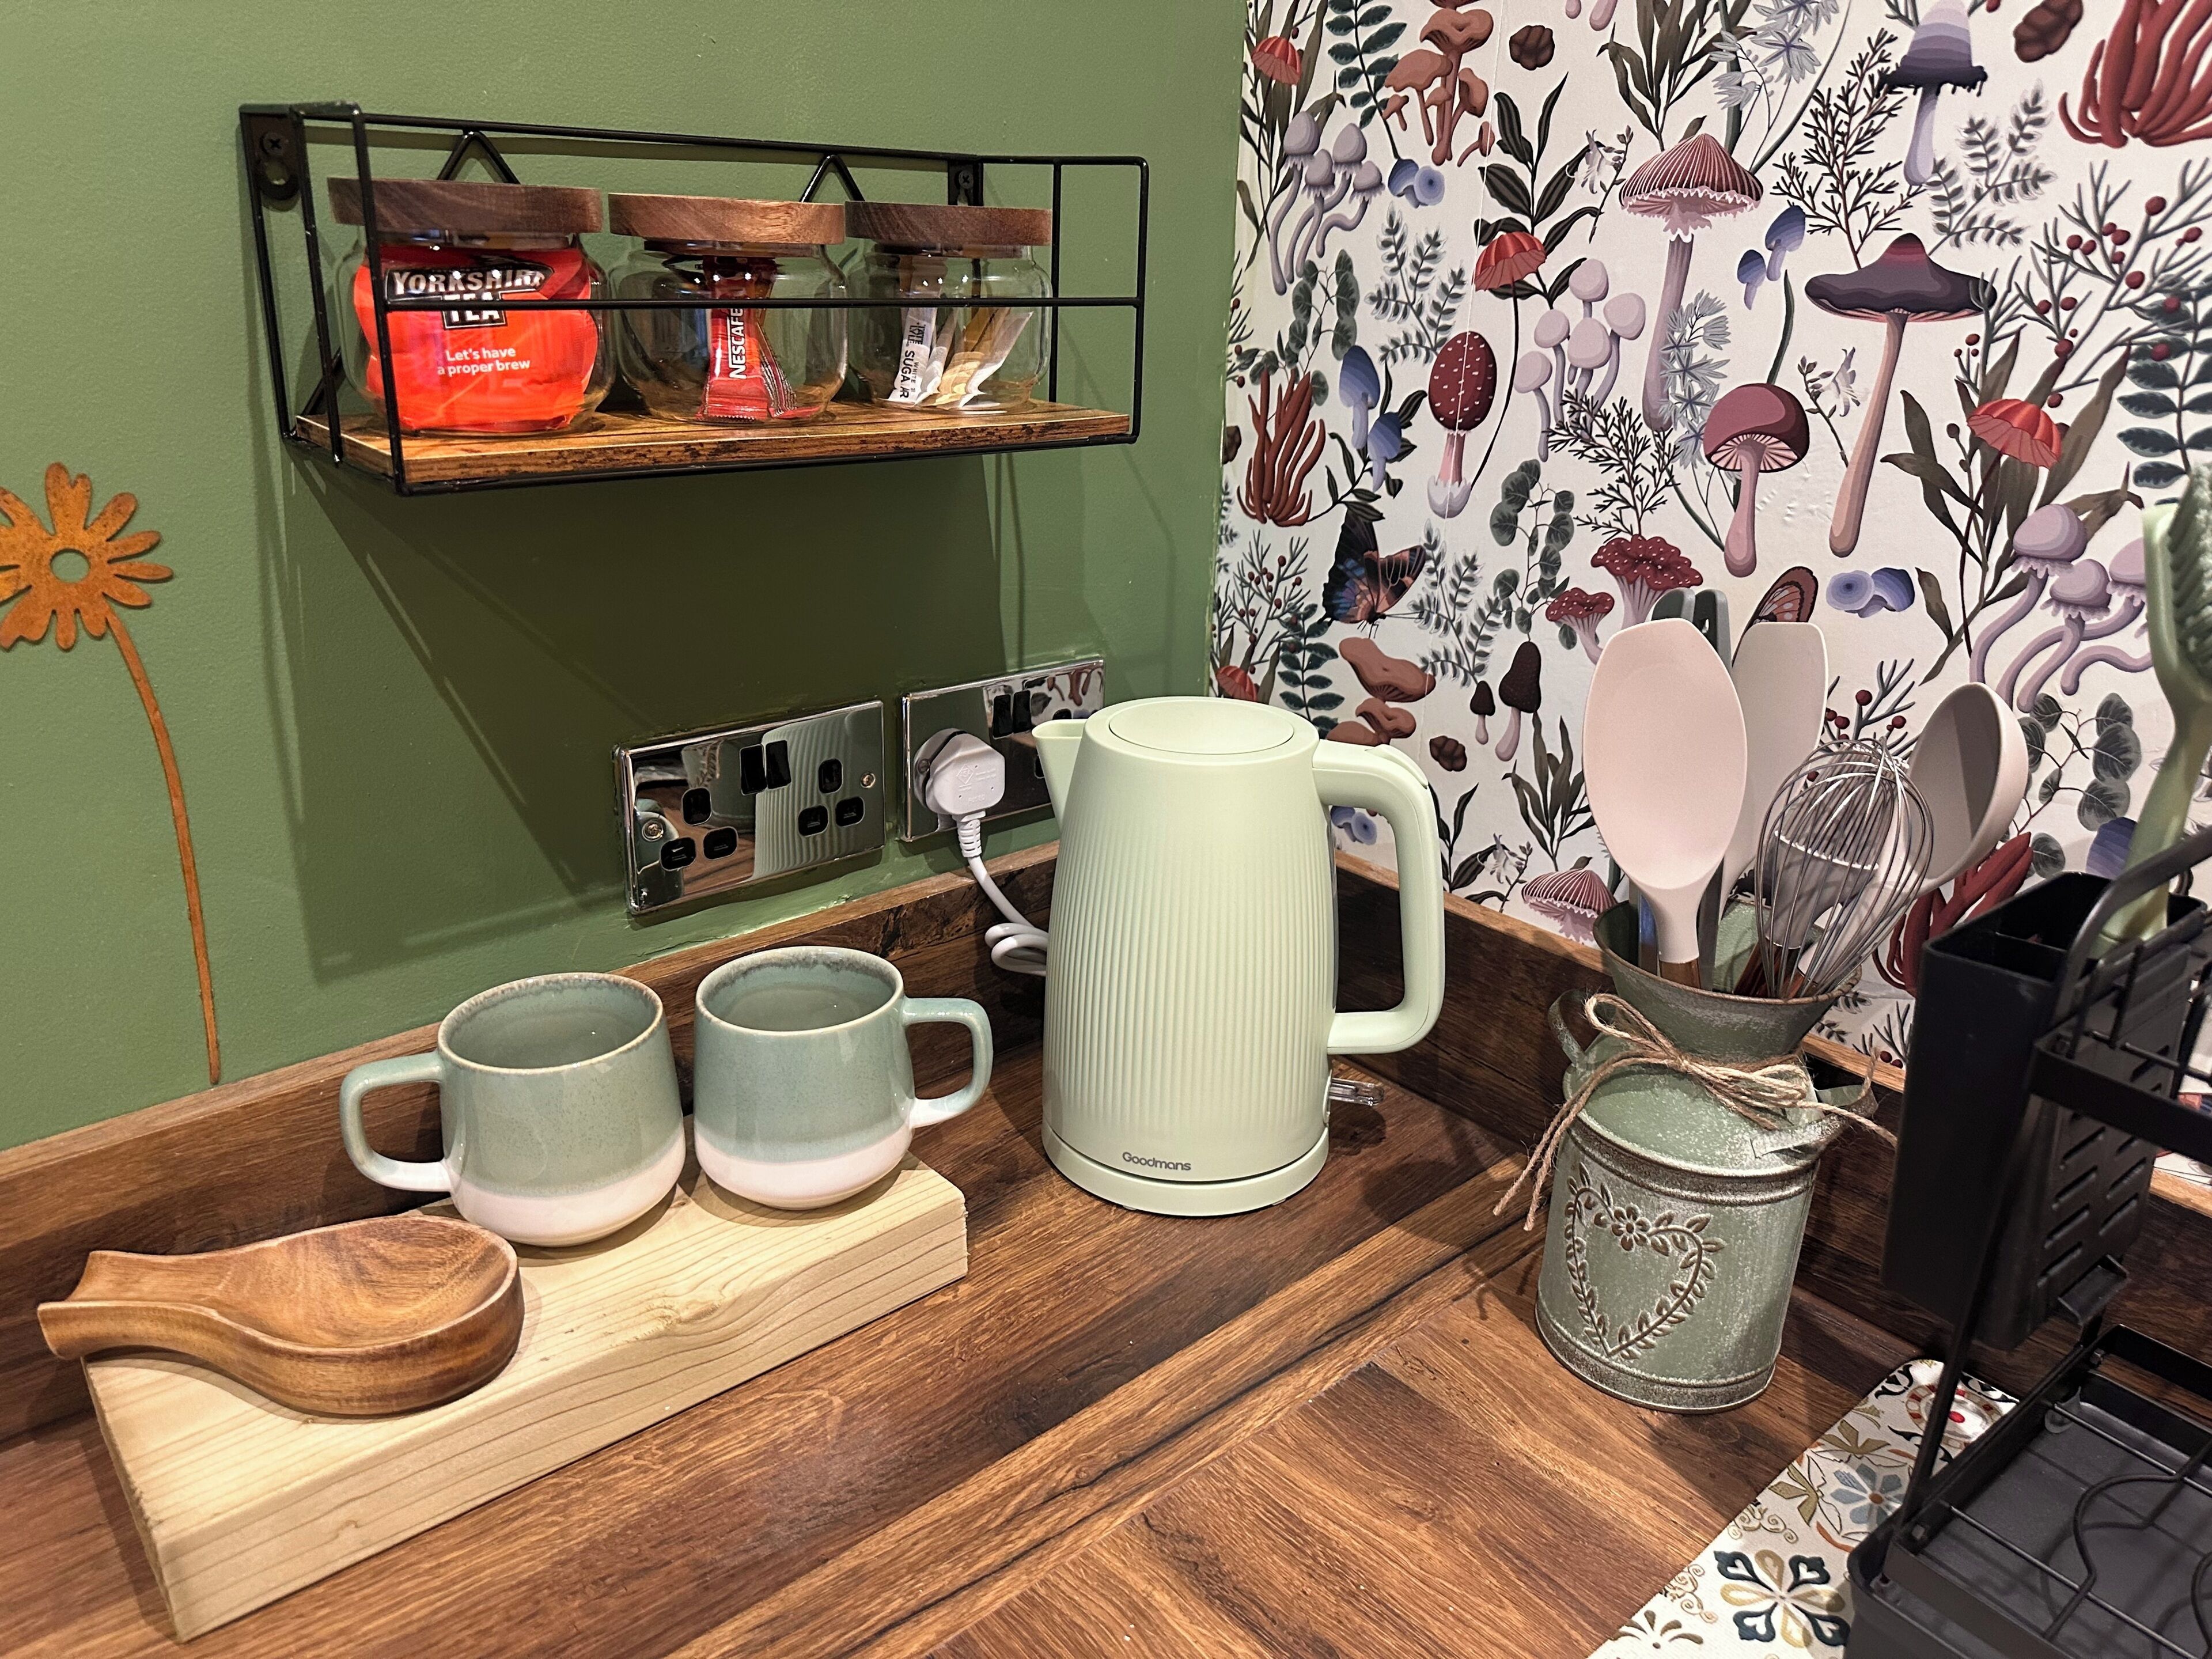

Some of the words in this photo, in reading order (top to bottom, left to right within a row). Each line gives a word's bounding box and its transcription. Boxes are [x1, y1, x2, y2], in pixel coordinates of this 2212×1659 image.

[443, 291, 501, 323] TEA
[445, 348, 480, 362] Let's
[482, 347, 516, 359] have
[437, 366, 445, 374] a
[448, 363, 494, 377] proper
[495, 359, 531, 372] brew
[911, 362, 919, 384] WHITE
[1122, 1152, 1191, 1171] Goodmans
